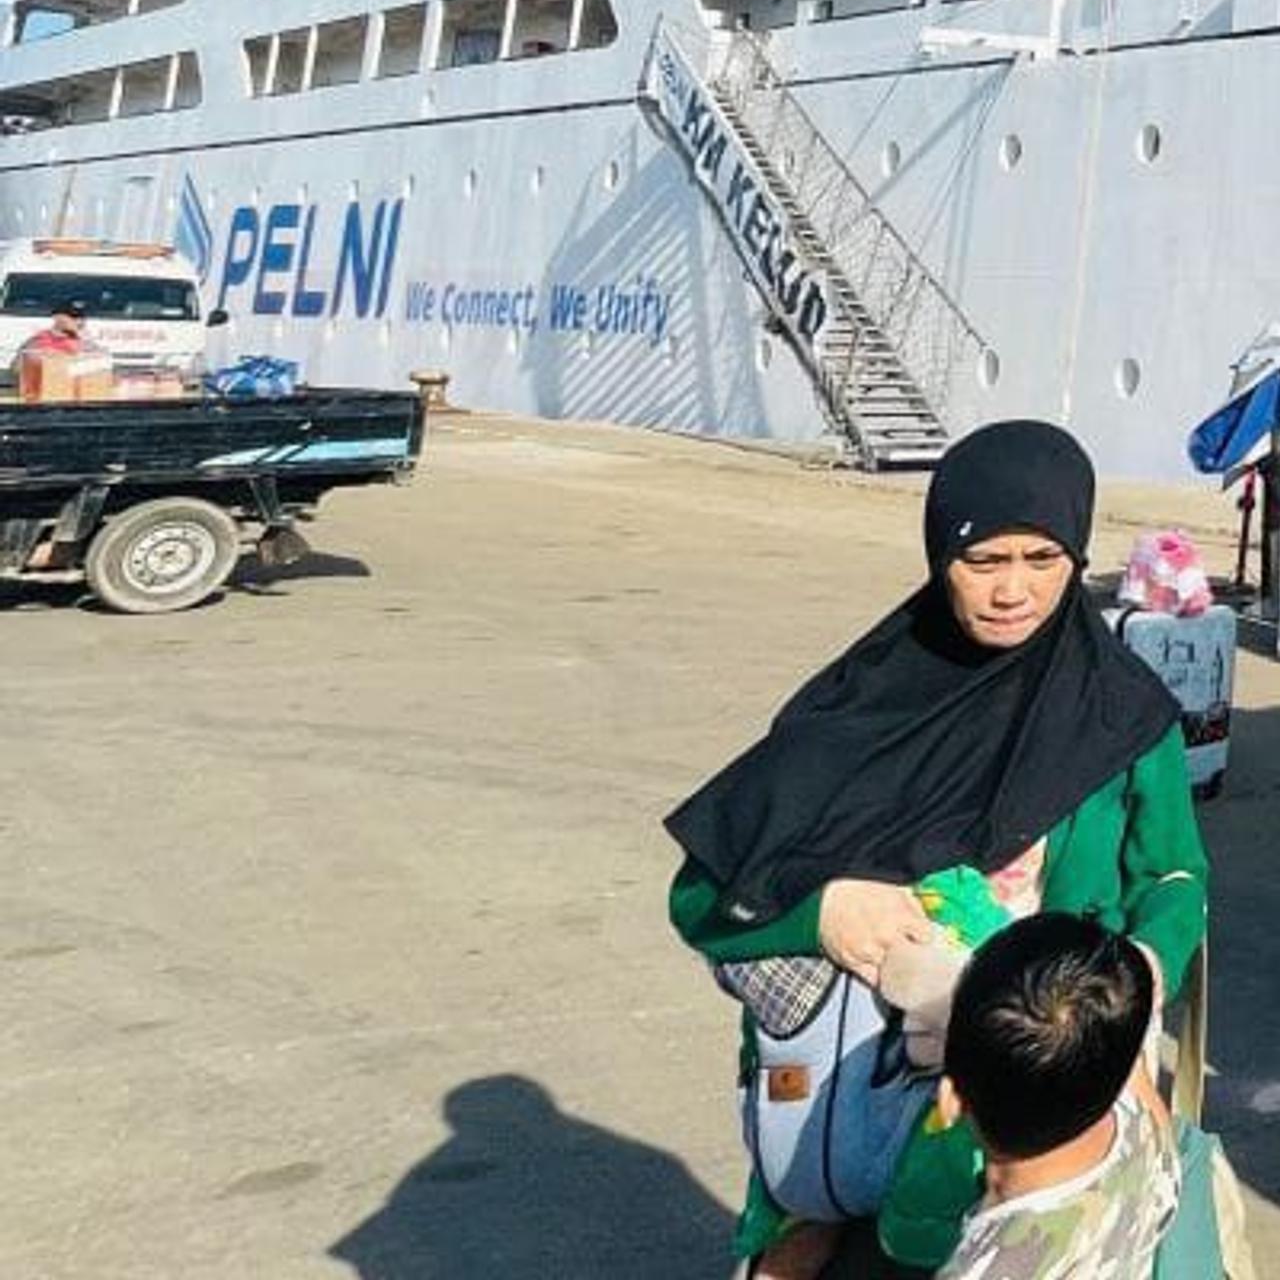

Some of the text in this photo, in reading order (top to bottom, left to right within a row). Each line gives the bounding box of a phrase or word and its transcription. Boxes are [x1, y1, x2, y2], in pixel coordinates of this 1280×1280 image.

[217, 197, 404, 319] PELNI
[405, 282, 436, 322] We
[551, 283, 588, 330] We
[595, 271, 670, 347] Unify
